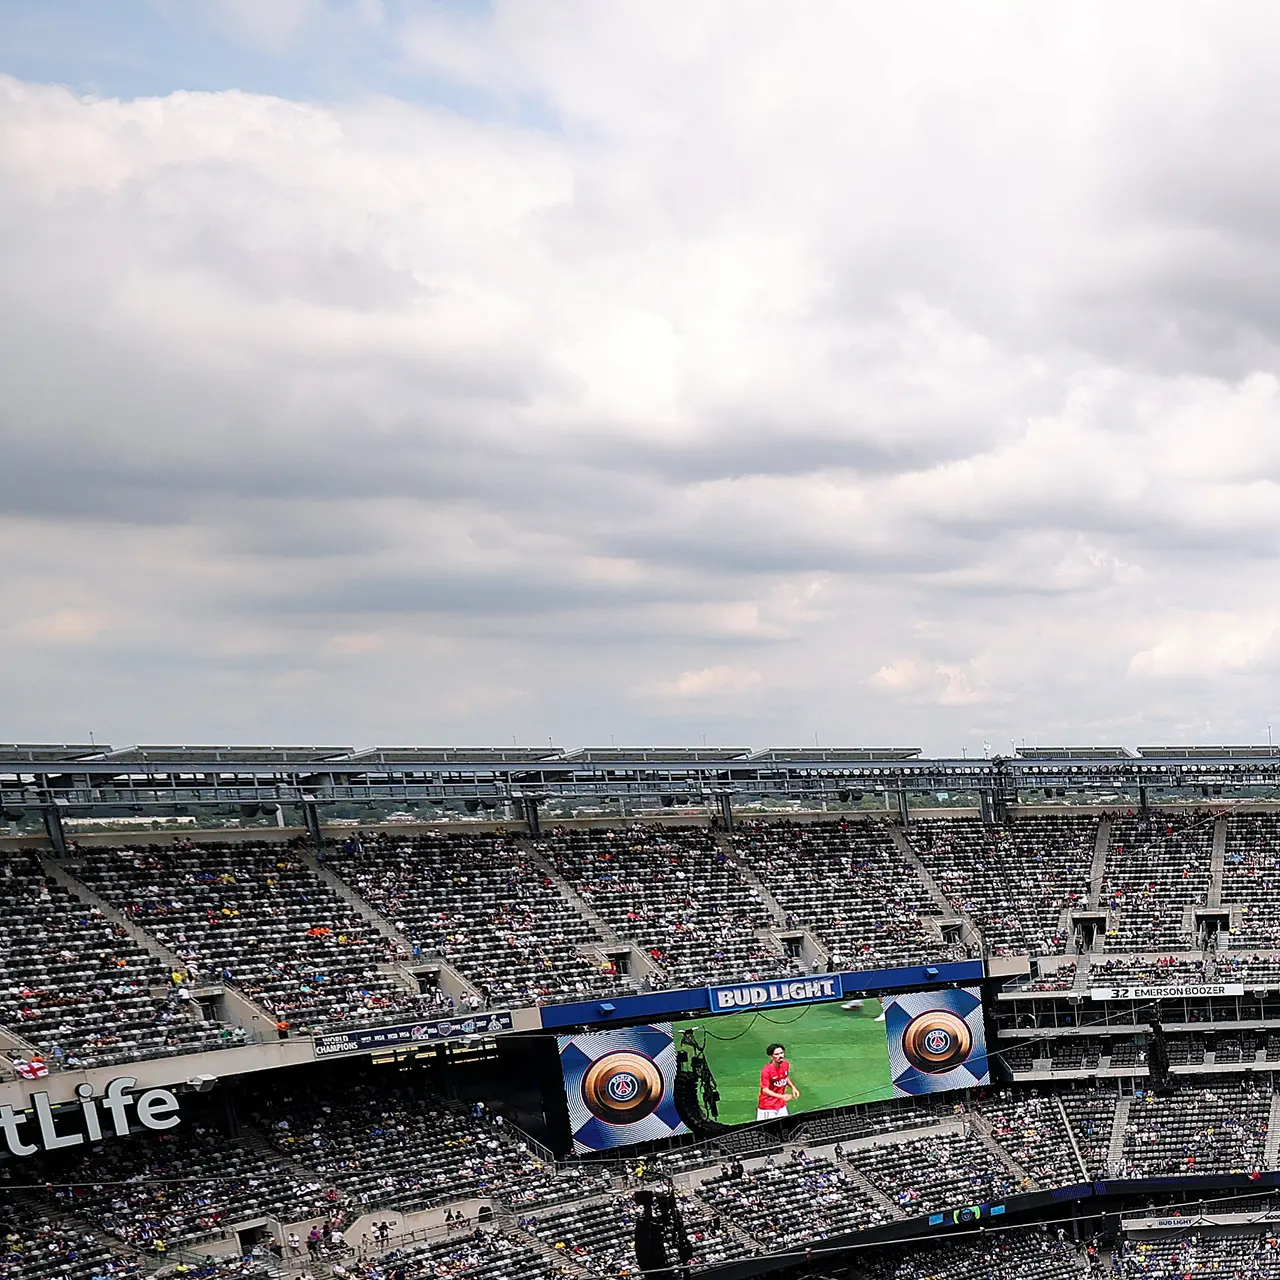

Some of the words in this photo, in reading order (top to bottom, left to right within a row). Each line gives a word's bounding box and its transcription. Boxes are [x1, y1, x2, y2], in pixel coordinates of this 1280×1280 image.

[717, 985, 768, 1009] BUD
[769, 978, 836, 1003] LIGHT
[1111, 988, 1129, 999] 32
[1134, 987, 1184, 998] EMERSON
[1184, 985, 1225, 996] BOOZER
[322, 1035, 349, 1046] WORLD
[316, 1041, 358, 1055] CHAMPIONS
[1158, 1219, 1174, 1227] BUD
[1174, 1218, 1192, 1226] LIGHT
